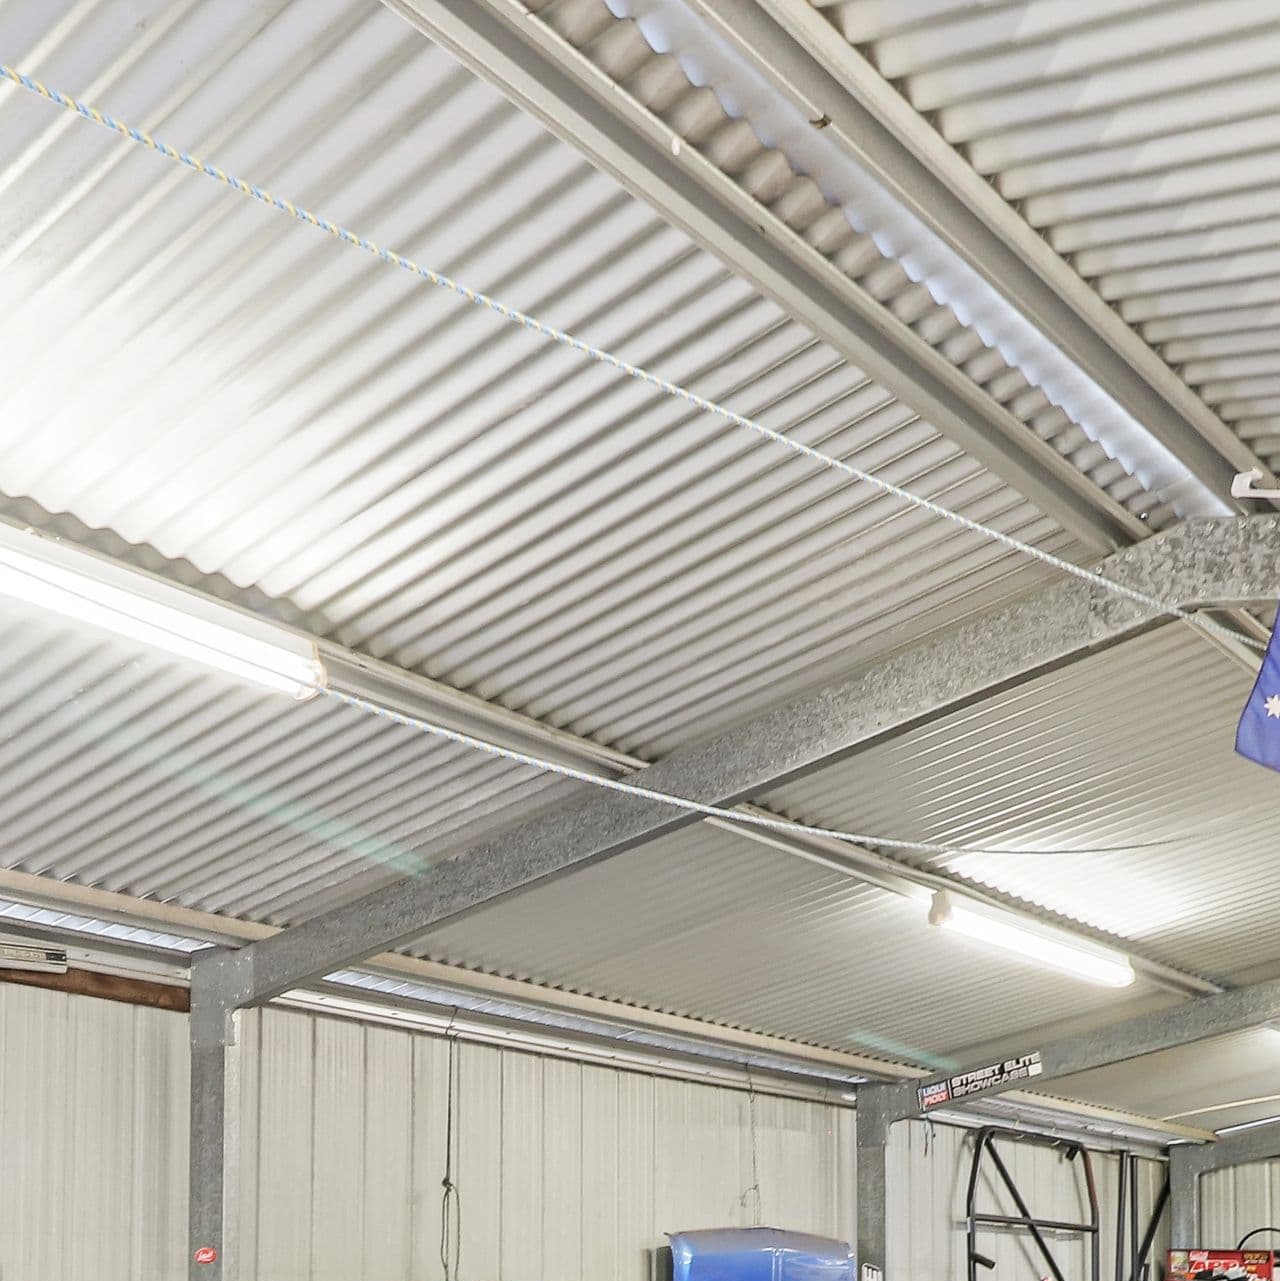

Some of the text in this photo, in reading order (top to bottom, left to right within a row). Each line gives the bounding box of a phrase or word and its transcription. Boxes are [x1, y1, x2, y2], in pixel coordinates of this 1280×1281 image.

[951, 1052, 1040, 1087] STREET ELITE
[952, 1068, 1029, 1098] SHOWCASE
